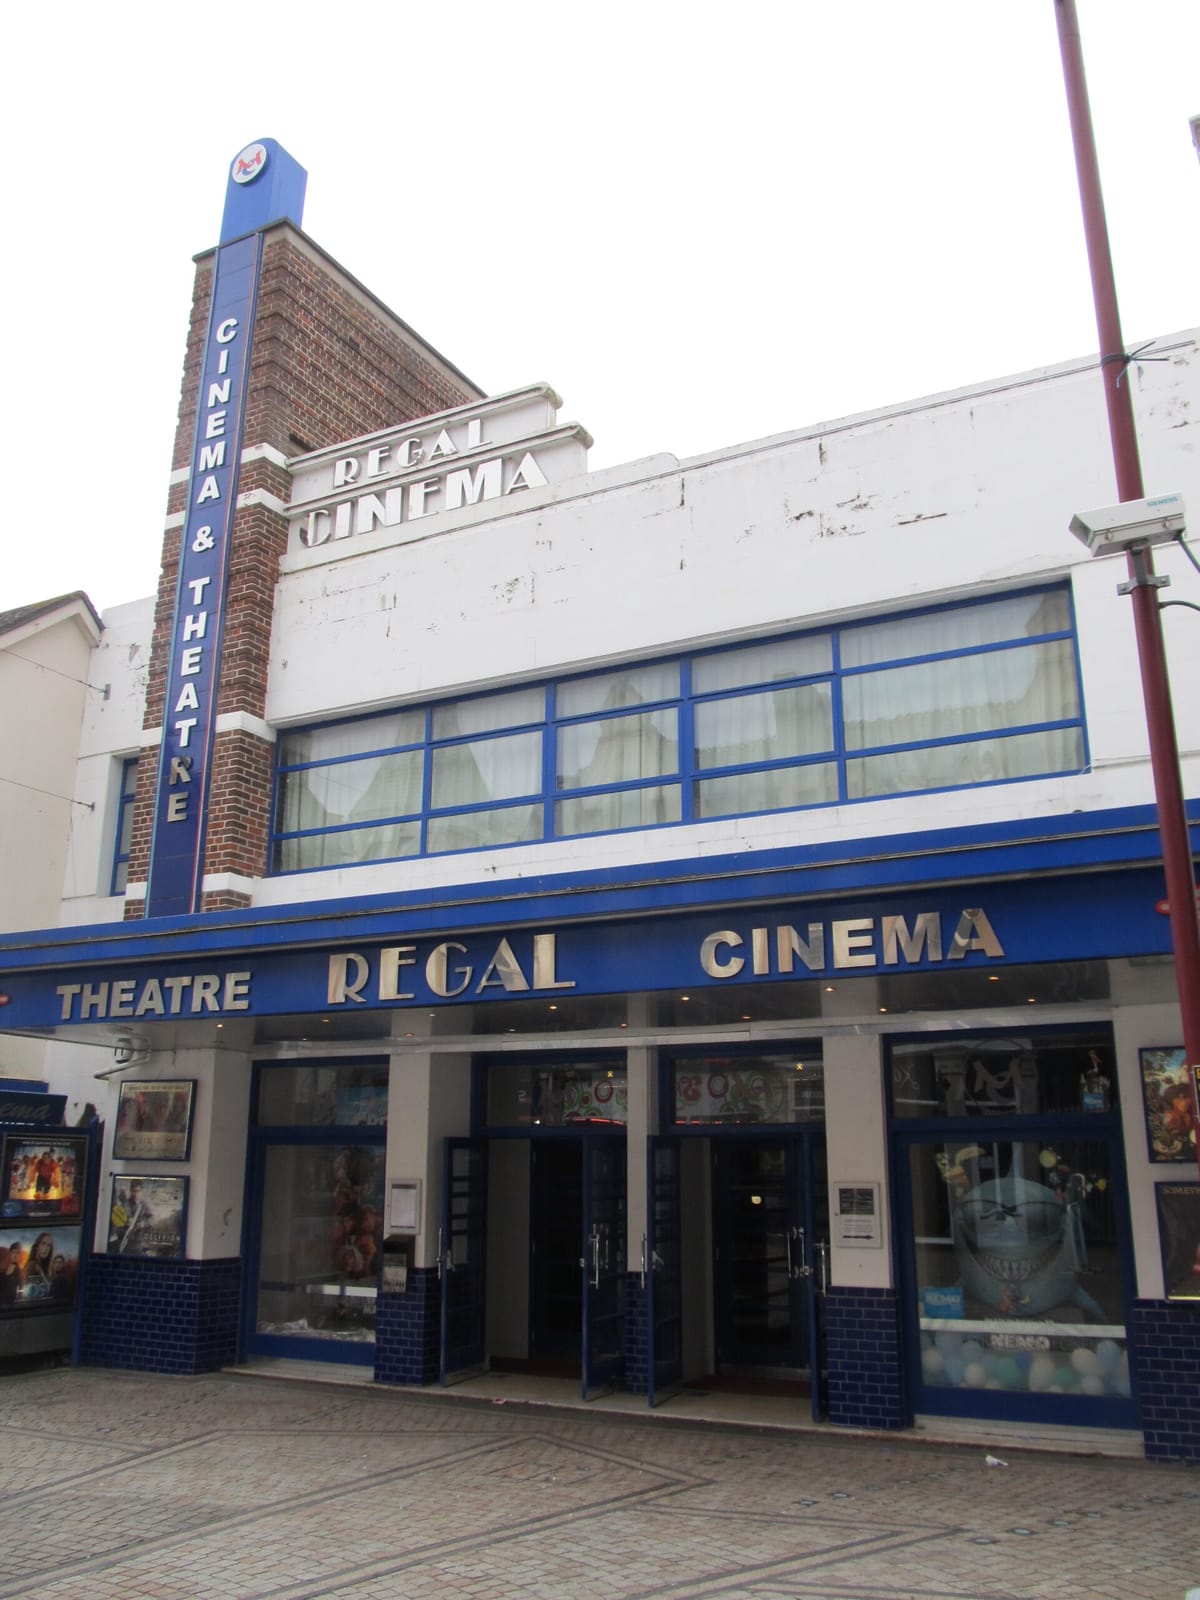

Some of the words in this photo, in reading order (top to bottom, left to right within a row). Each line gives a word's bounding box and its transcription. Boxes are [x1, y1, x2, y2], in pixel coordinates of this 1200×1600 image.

[196, 317, 239, 505] CINEMA
[333, 418, 493, 489] REGAL
[191, 525, 216, 554] &
[299, 451, 551, 548] CINEMA
[166, 576, 211, 823] THEATRE
[56, 971, 253, 1021] THEATRE
[327, 932, 577, 1006] REGAL
[700, 907, 1006, 979] CINEMA
